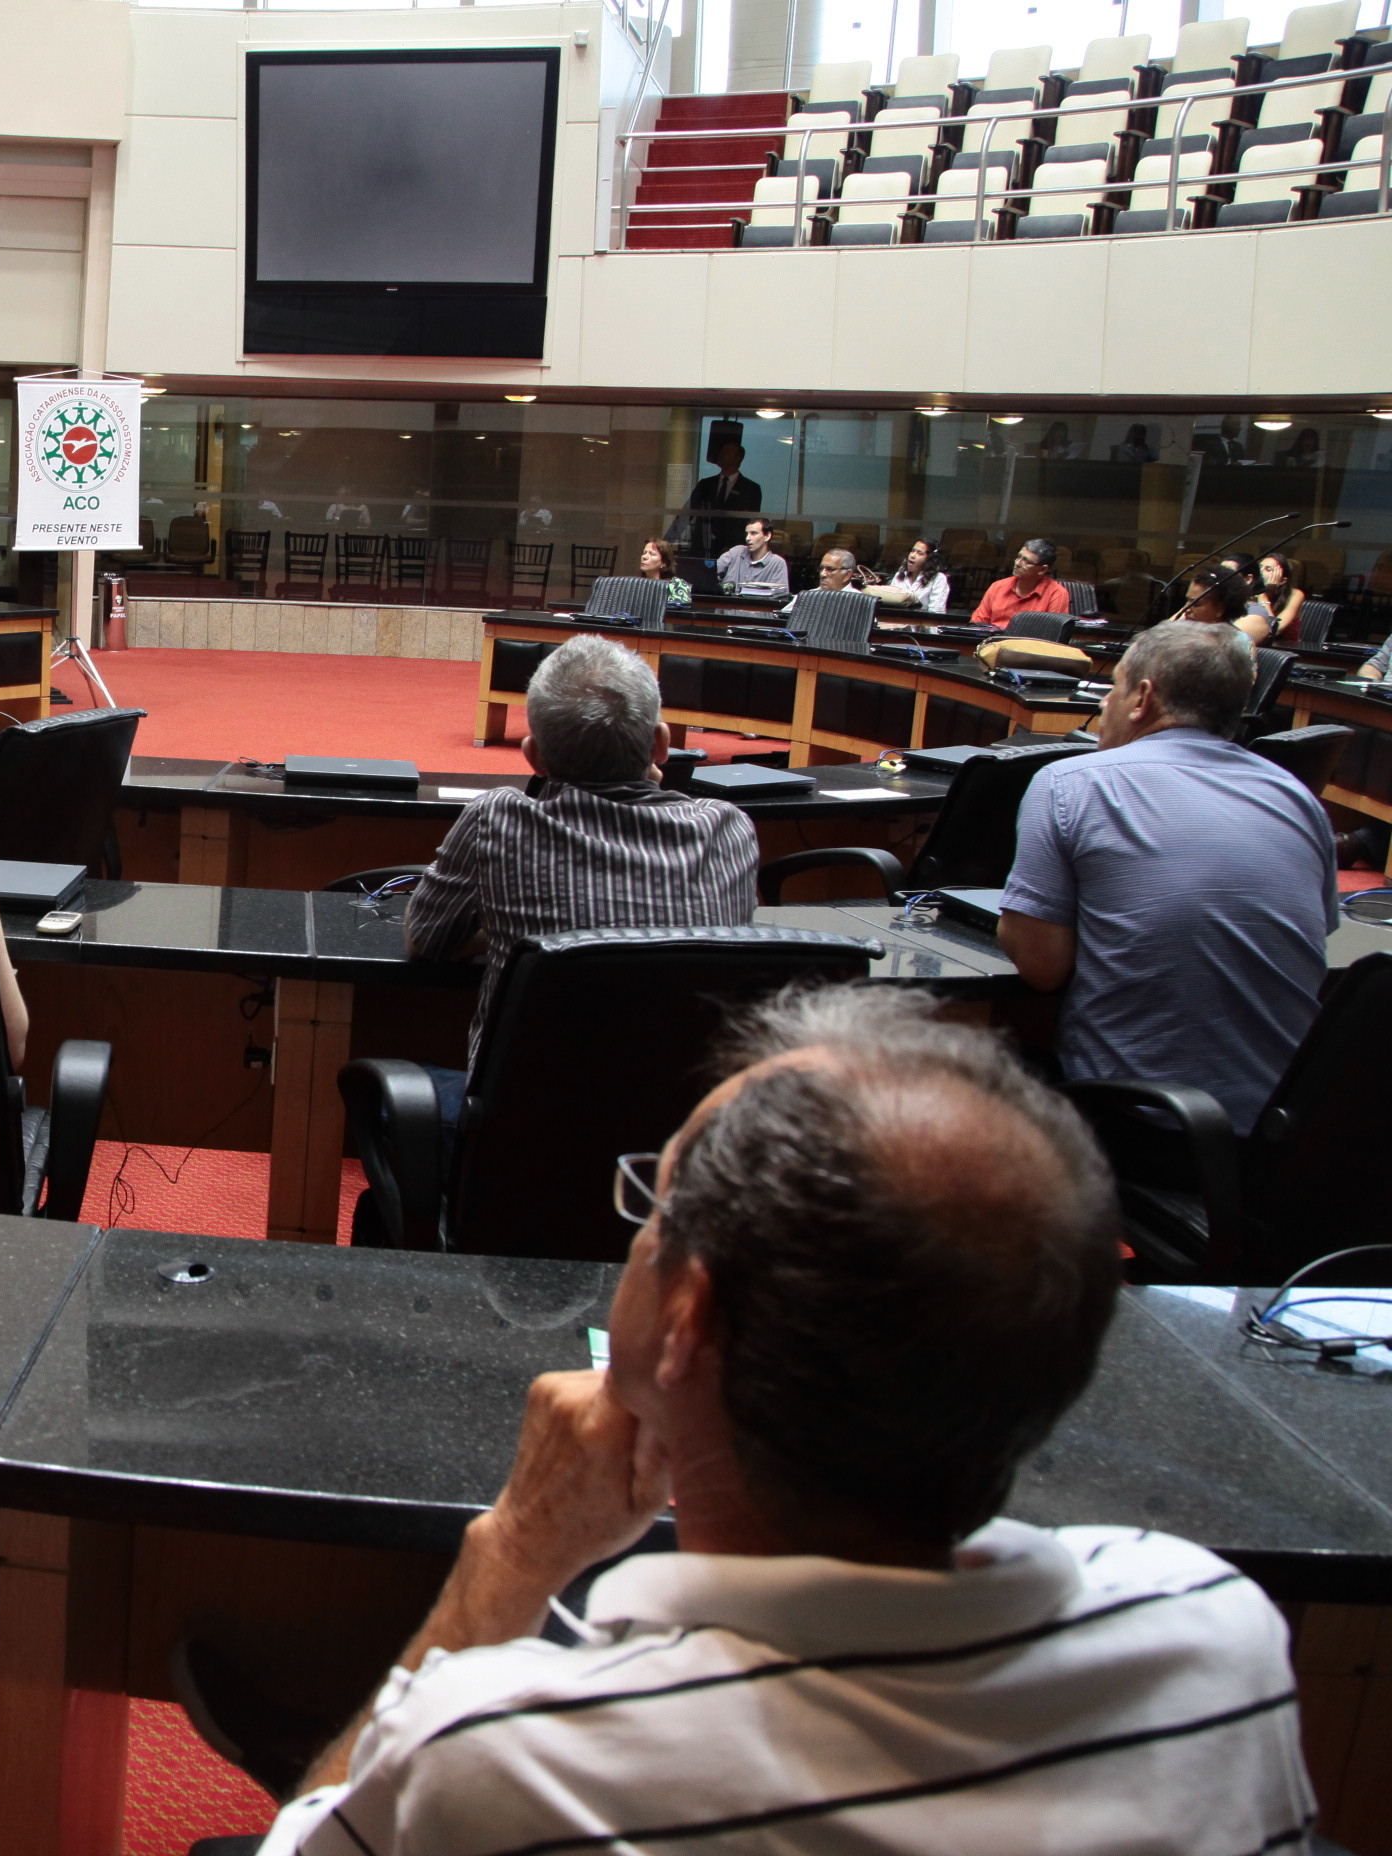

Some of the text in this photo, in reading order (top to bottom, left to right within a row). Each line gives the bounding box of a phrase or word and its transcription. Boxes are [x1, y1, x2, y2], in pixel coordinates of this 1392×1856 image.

[25, 387, 132, 483] ASSOCIAÇÃO CATARINENSE DA PESSOA OSTOMIZADA
[62, 496, 101, 511] ACO
[31, 523, 123, 533] PRESENTE NESTE
[56, 536, 99, 546] EVENTO
